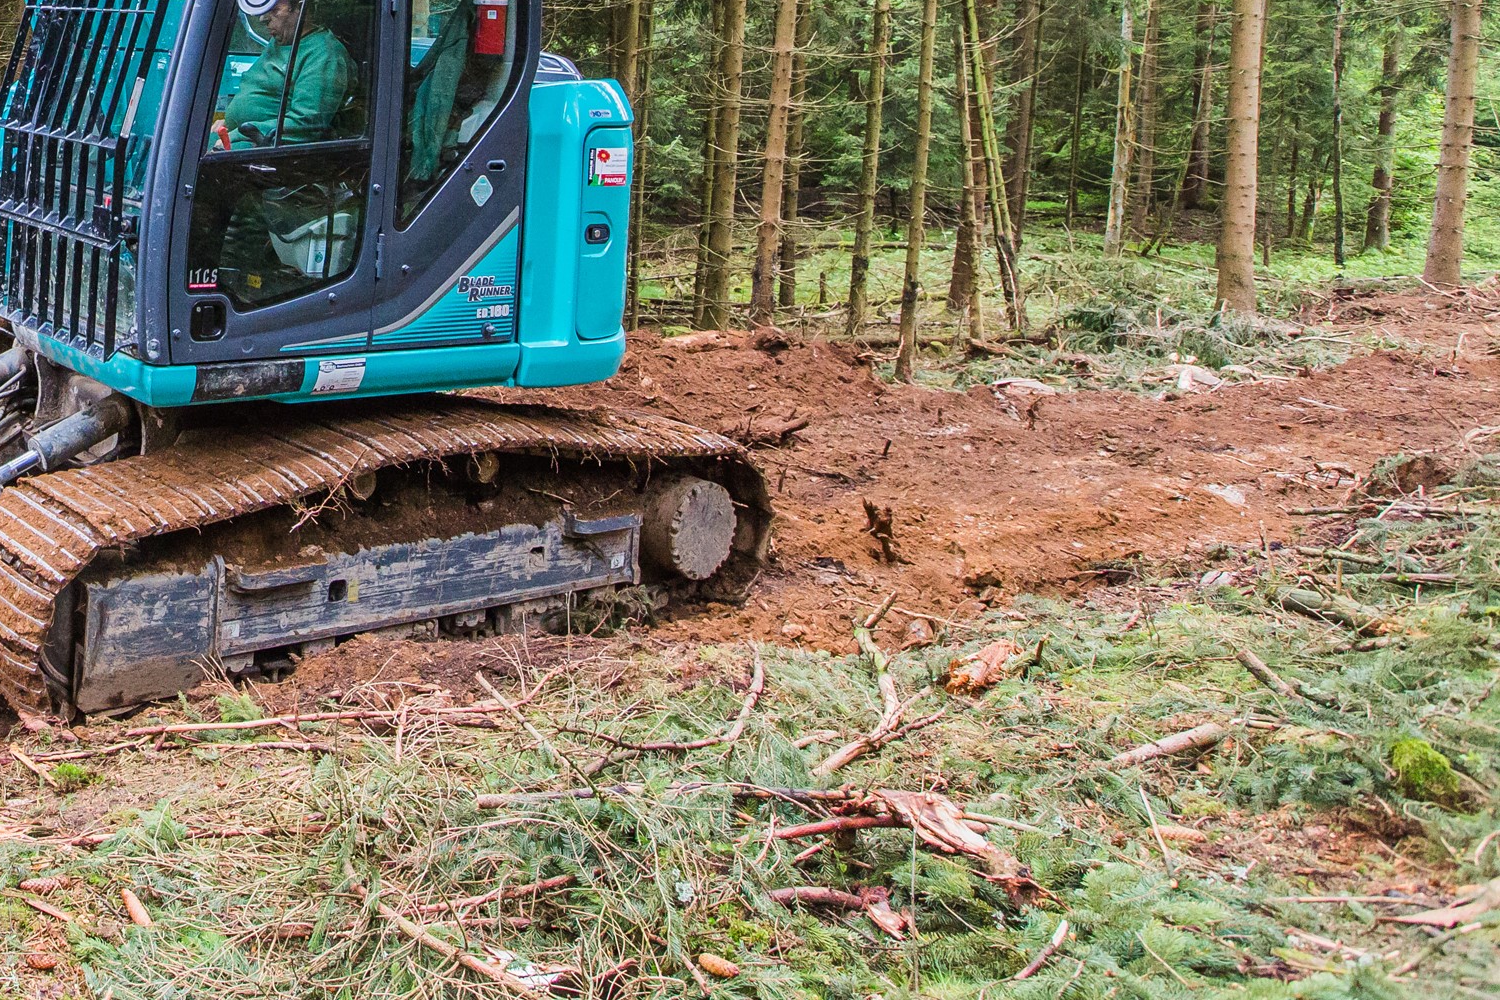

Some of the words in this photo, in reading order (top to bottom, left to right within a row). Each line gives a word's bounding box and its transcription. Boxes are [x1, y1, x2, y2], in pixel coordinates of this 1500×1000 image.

[189, 268, 218, 284] ITCS
[457, 276, 495, 294] BLADE
[467, 285, 512, 302] RUNNER
